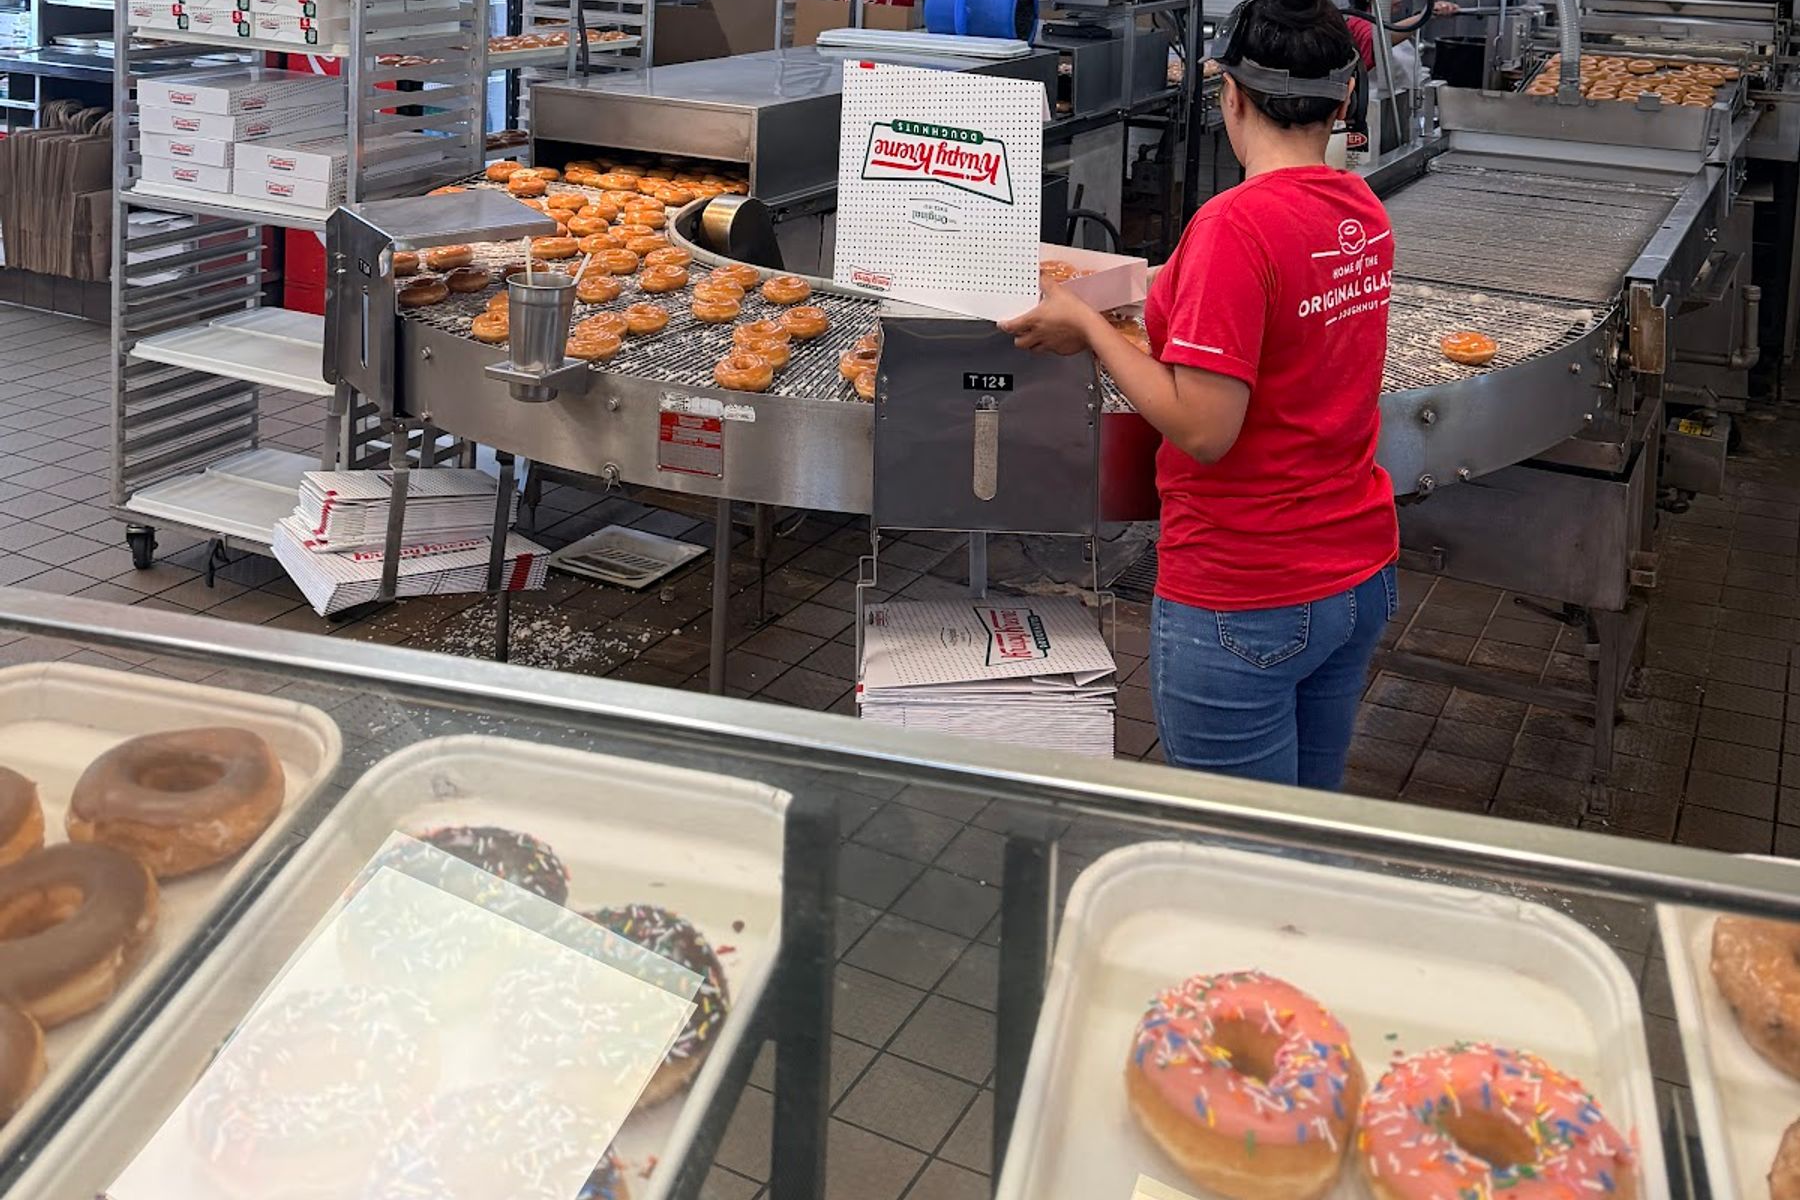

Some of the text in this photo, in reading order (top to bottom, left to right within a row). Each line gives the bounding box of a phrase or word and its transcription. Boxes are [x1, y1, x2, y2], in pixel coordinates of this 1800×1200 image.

[898, 121, 978, 142] DOUGHNUTS
[871, 139, 1001, 186] Krispy Kreme
[1333, 253, 1378, 279] HOME of THE
[1298, 280, 1361, 318] ORIGINAL
[969, 375, 997, 388] T 12
